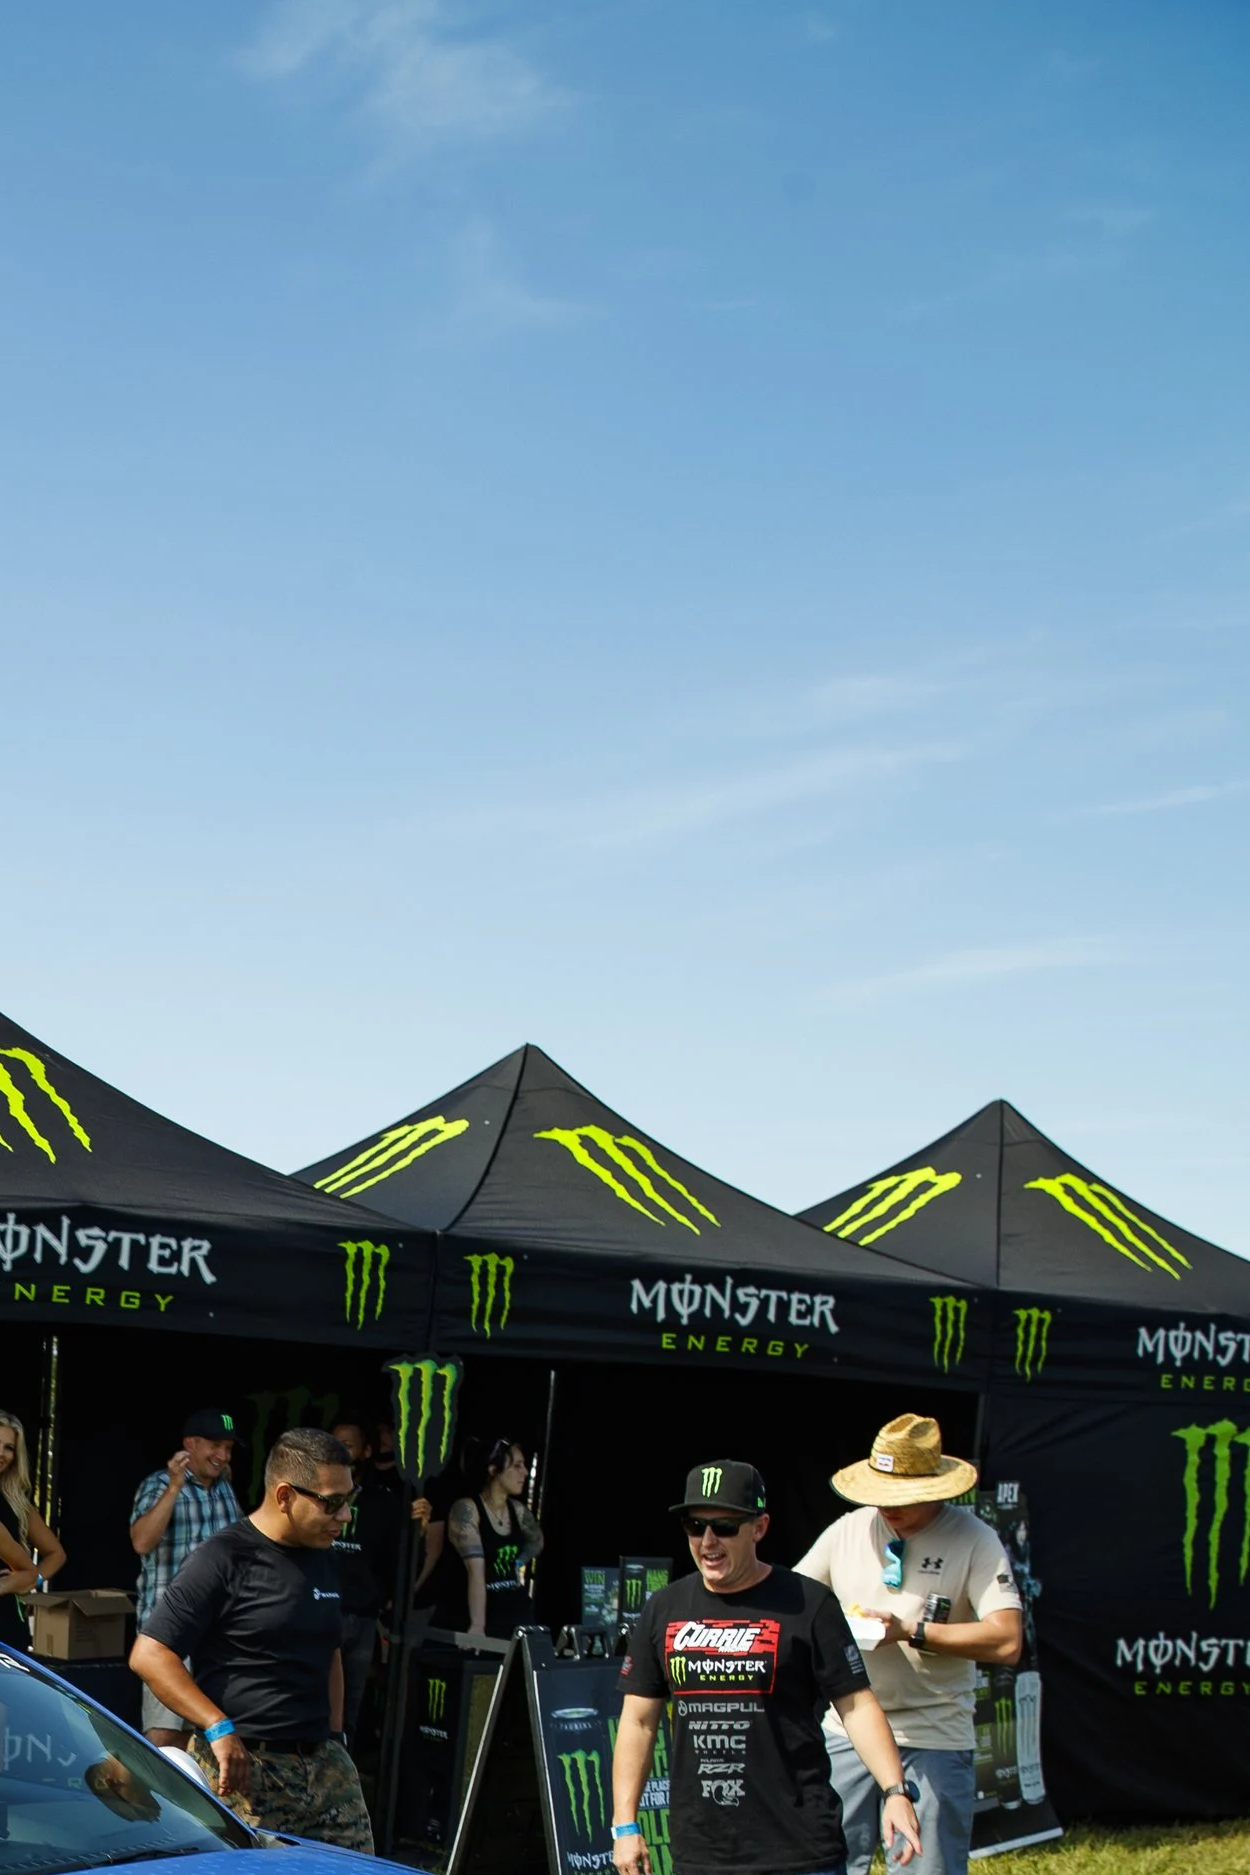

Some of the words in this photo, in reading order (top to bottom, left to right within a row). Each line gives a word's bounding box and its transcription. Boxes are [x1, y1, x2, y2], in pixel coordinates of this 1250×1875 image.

[629, 1274, 839, 1334] MONSTER
[661, 1333, 810, 1359] ENERGY
[673, 1621, 761, 1651] CURRIE
[688, 1659, 766, 1675] MONSTER
[688, 1703, 765, 1713] MAGPUL
[689, 1721, 750, 1730] NITTO
[693, 1735, 746, 1749] KMC
[698, 1763, 746, 1775] RZR
[701, 1779, 745, 1804] FOX
